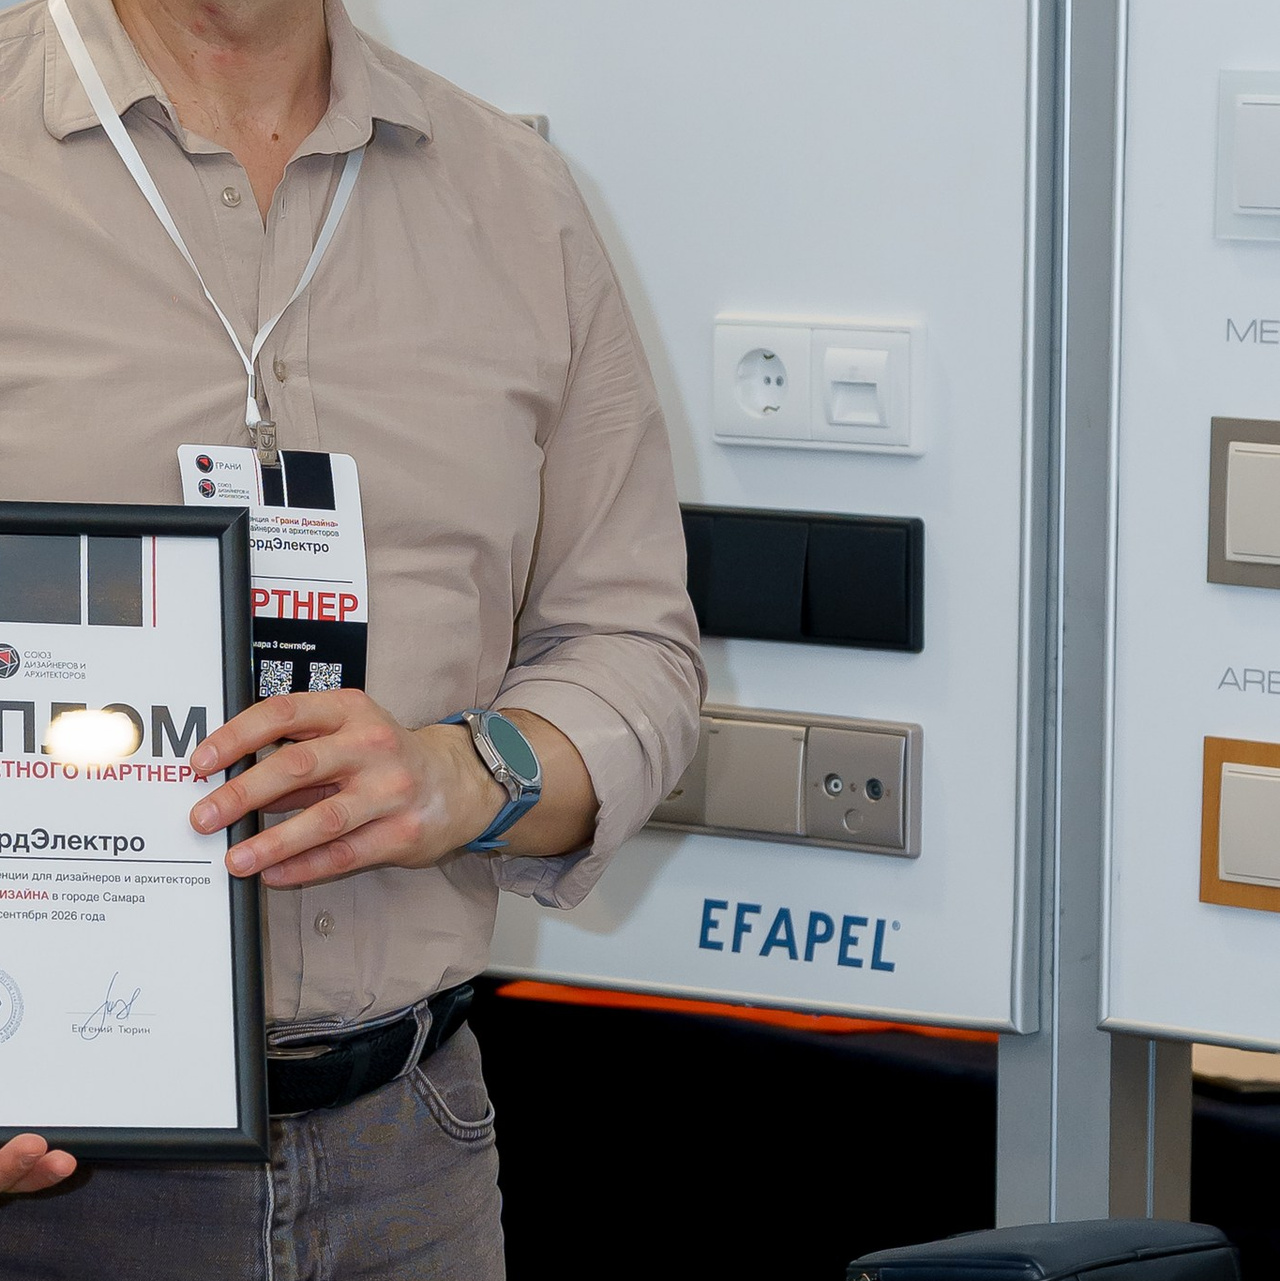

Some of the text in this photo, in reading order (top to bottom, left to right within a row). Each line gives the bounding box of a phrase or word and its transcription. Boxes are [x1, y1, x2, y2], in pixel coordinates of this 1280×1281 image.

[250, 537, 330, 555] ордЭлектро
[251, 588, 359, 622] РТНЕР
[273, 641, 278, 649] 3
[279, 641, 317, 652] сентября
[23, 650, 52, 659] СОЮЗ
[23, 661, 79, 670] ДИЗАЙНЕРОВ
[23, 671, 87, 680] АРХИТЕКТОРОВ
[31, 873, 52, 881] для
[55, 872, 121, 883] дизайнеров
[134, 875, 211, 886] архитекторов
[52, 893, 59, 901] в
[61, 892, 100, 903] городе
[102, 892, 145, 904] Самара
[51, 910, 78, 921] 2026
[80, 913, 106, 922] года
[118, 1024, 151, 1035] Тюрин
